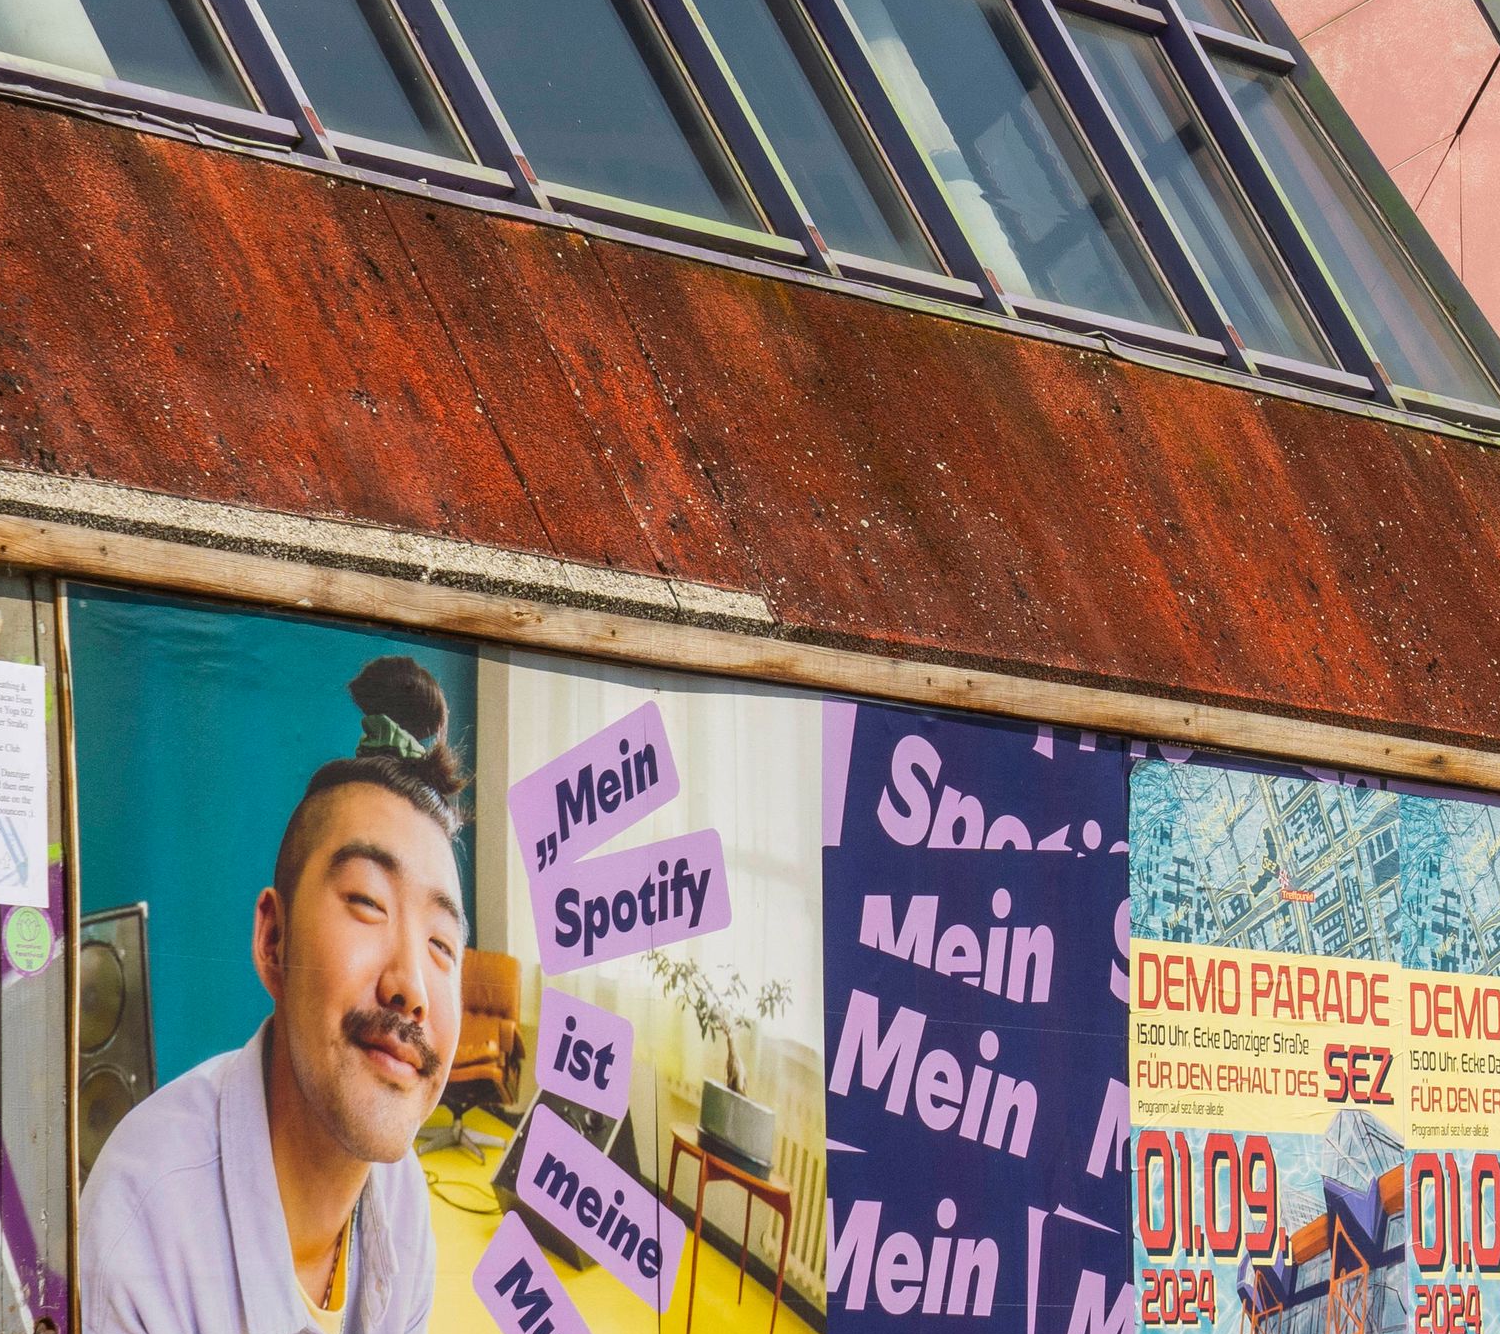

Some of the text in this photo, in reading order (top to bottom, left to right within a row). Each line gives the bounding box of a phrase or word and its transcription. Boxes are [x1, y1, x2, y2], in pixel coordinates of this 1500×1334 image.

[553, 859, 713, 958] Spotify
[1281, 889, 1315, 903] Treffpunkt
[859, 888, 1055, 1004] Mein
[1138, 952, 1390, 1026] DEMO PARADE
[553, 1015, 617, 1090] ist
[828, 988, 1038, 1159] Mein
[1136, 1023, 1166, 1046] 15:00
[1193, 1027, 1221, 1049] Ecke
[1222, 1028, 1271, 1057] Danziger
[1272, 1033, 1309, 1055] Straße
[1137, 1043, 1394, 1105] FÜR DEN ERHALT DES SEZ
[1138, 1099, 1168, 1118] Programm
[1169, 1102, 1180, 1115] auf
[532, 1145, 664, 1278] meine
[1137, 1129, 1289, 1257] 01.09.
[1141, 1269, 1216, 1325] 2024
